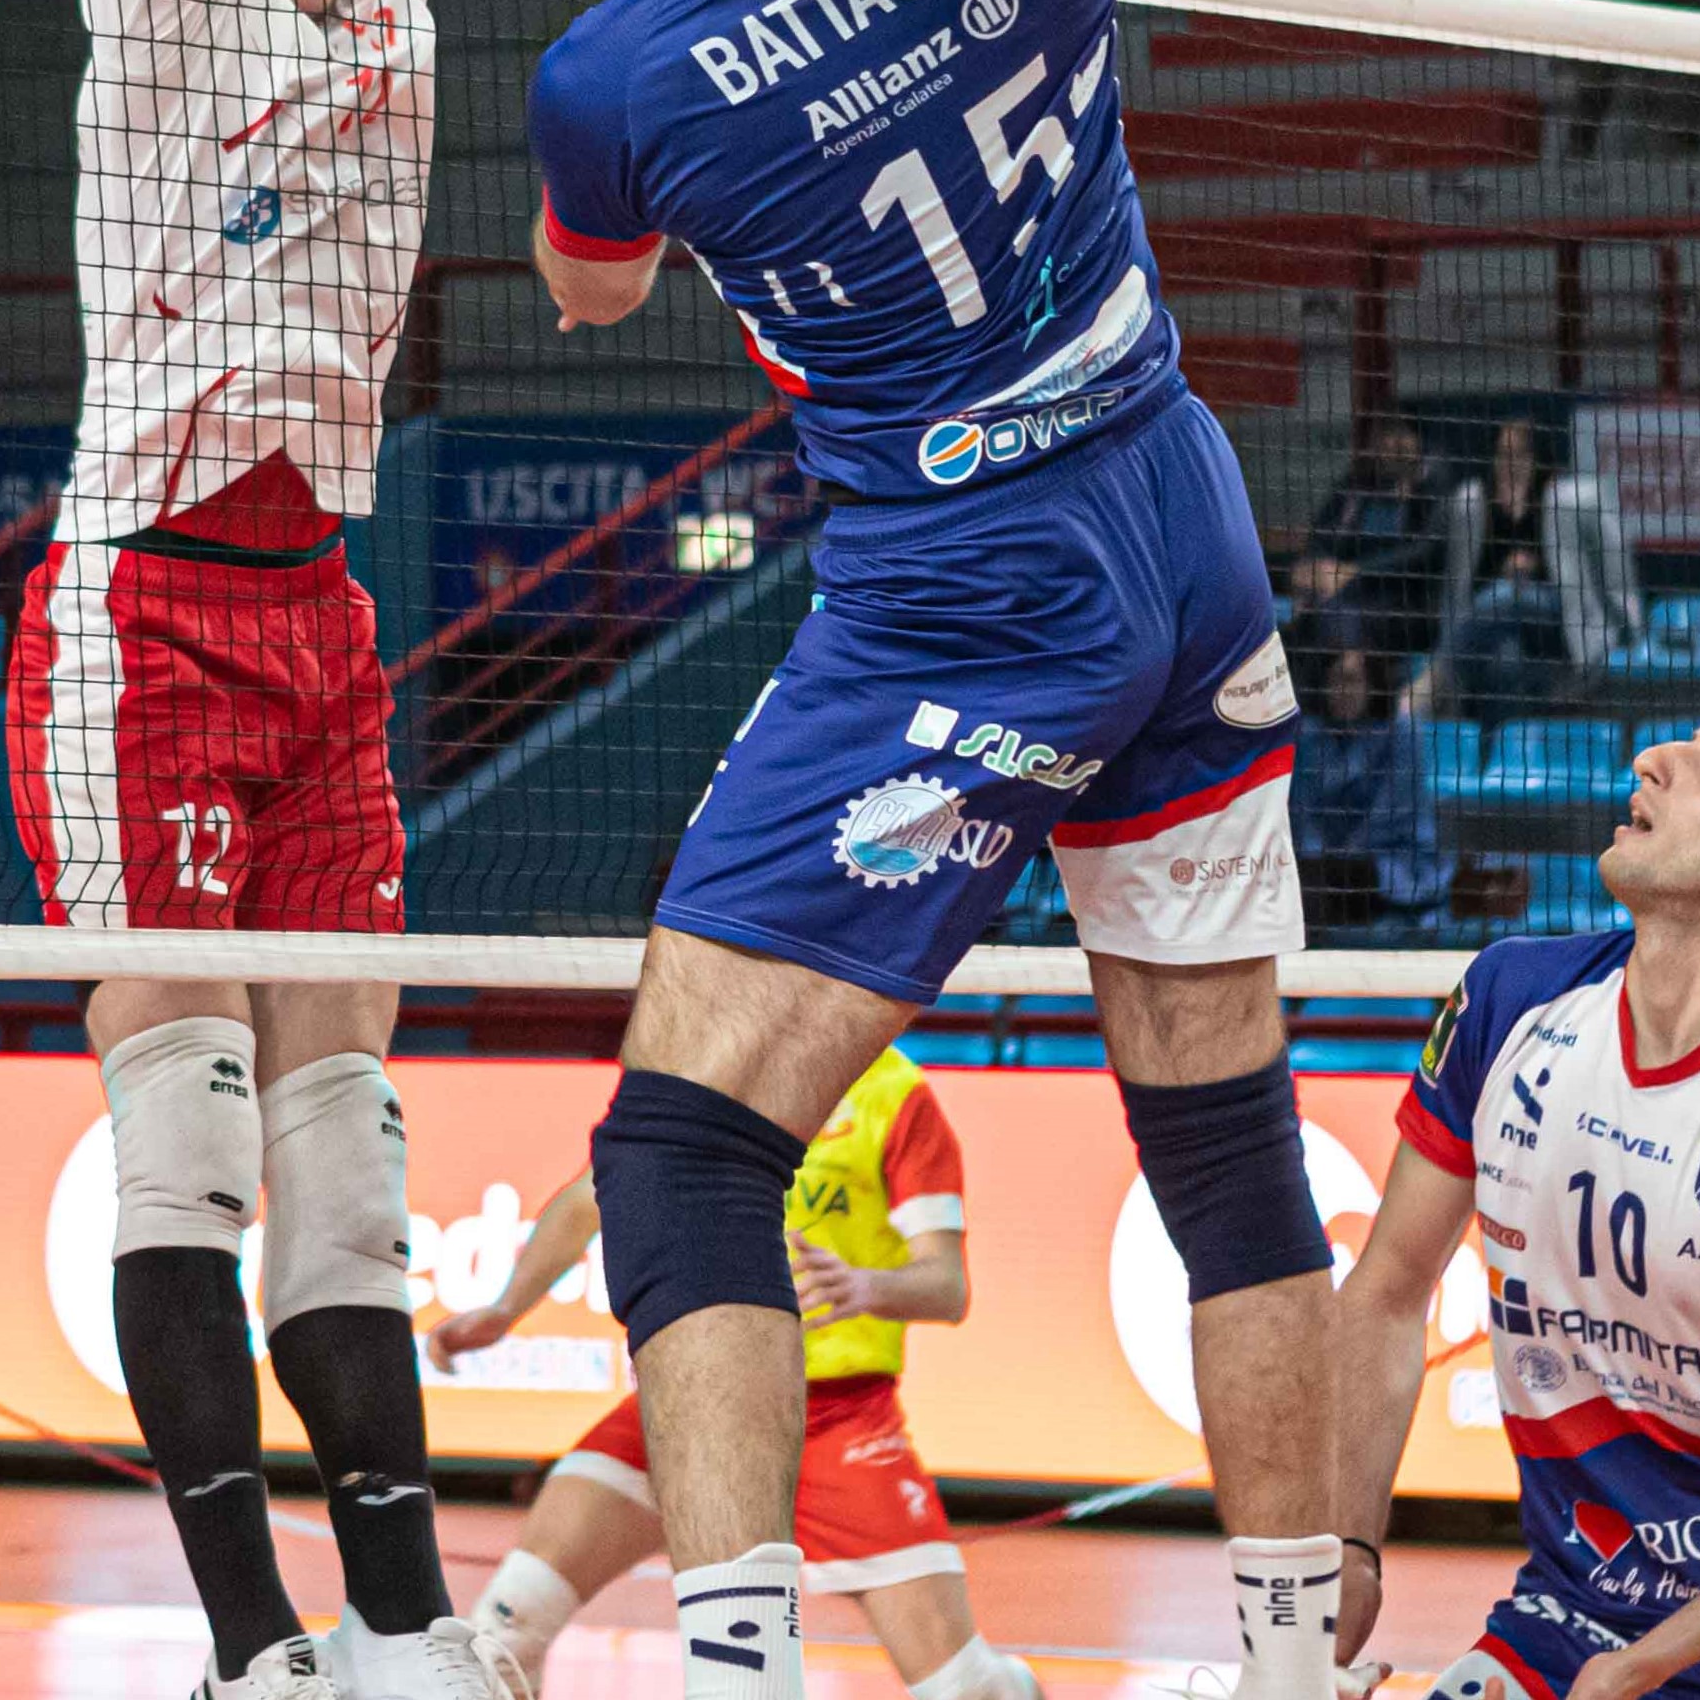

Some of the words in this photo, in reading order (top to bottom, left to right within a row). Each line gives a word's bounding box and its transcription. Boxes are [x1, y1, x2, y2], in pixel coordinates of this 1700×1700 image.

[803, 25, 963, 143] Allianz
[820, 112, 892, 161] Agenzia
[893, 70, 954, 120] Galatea
[859, 52, 1075, 329] 15
[161, 801, 231, 897] 12
[1567, 1168, 1647, 1299] 10
[1265, 1577, 1297, 1627] nine
